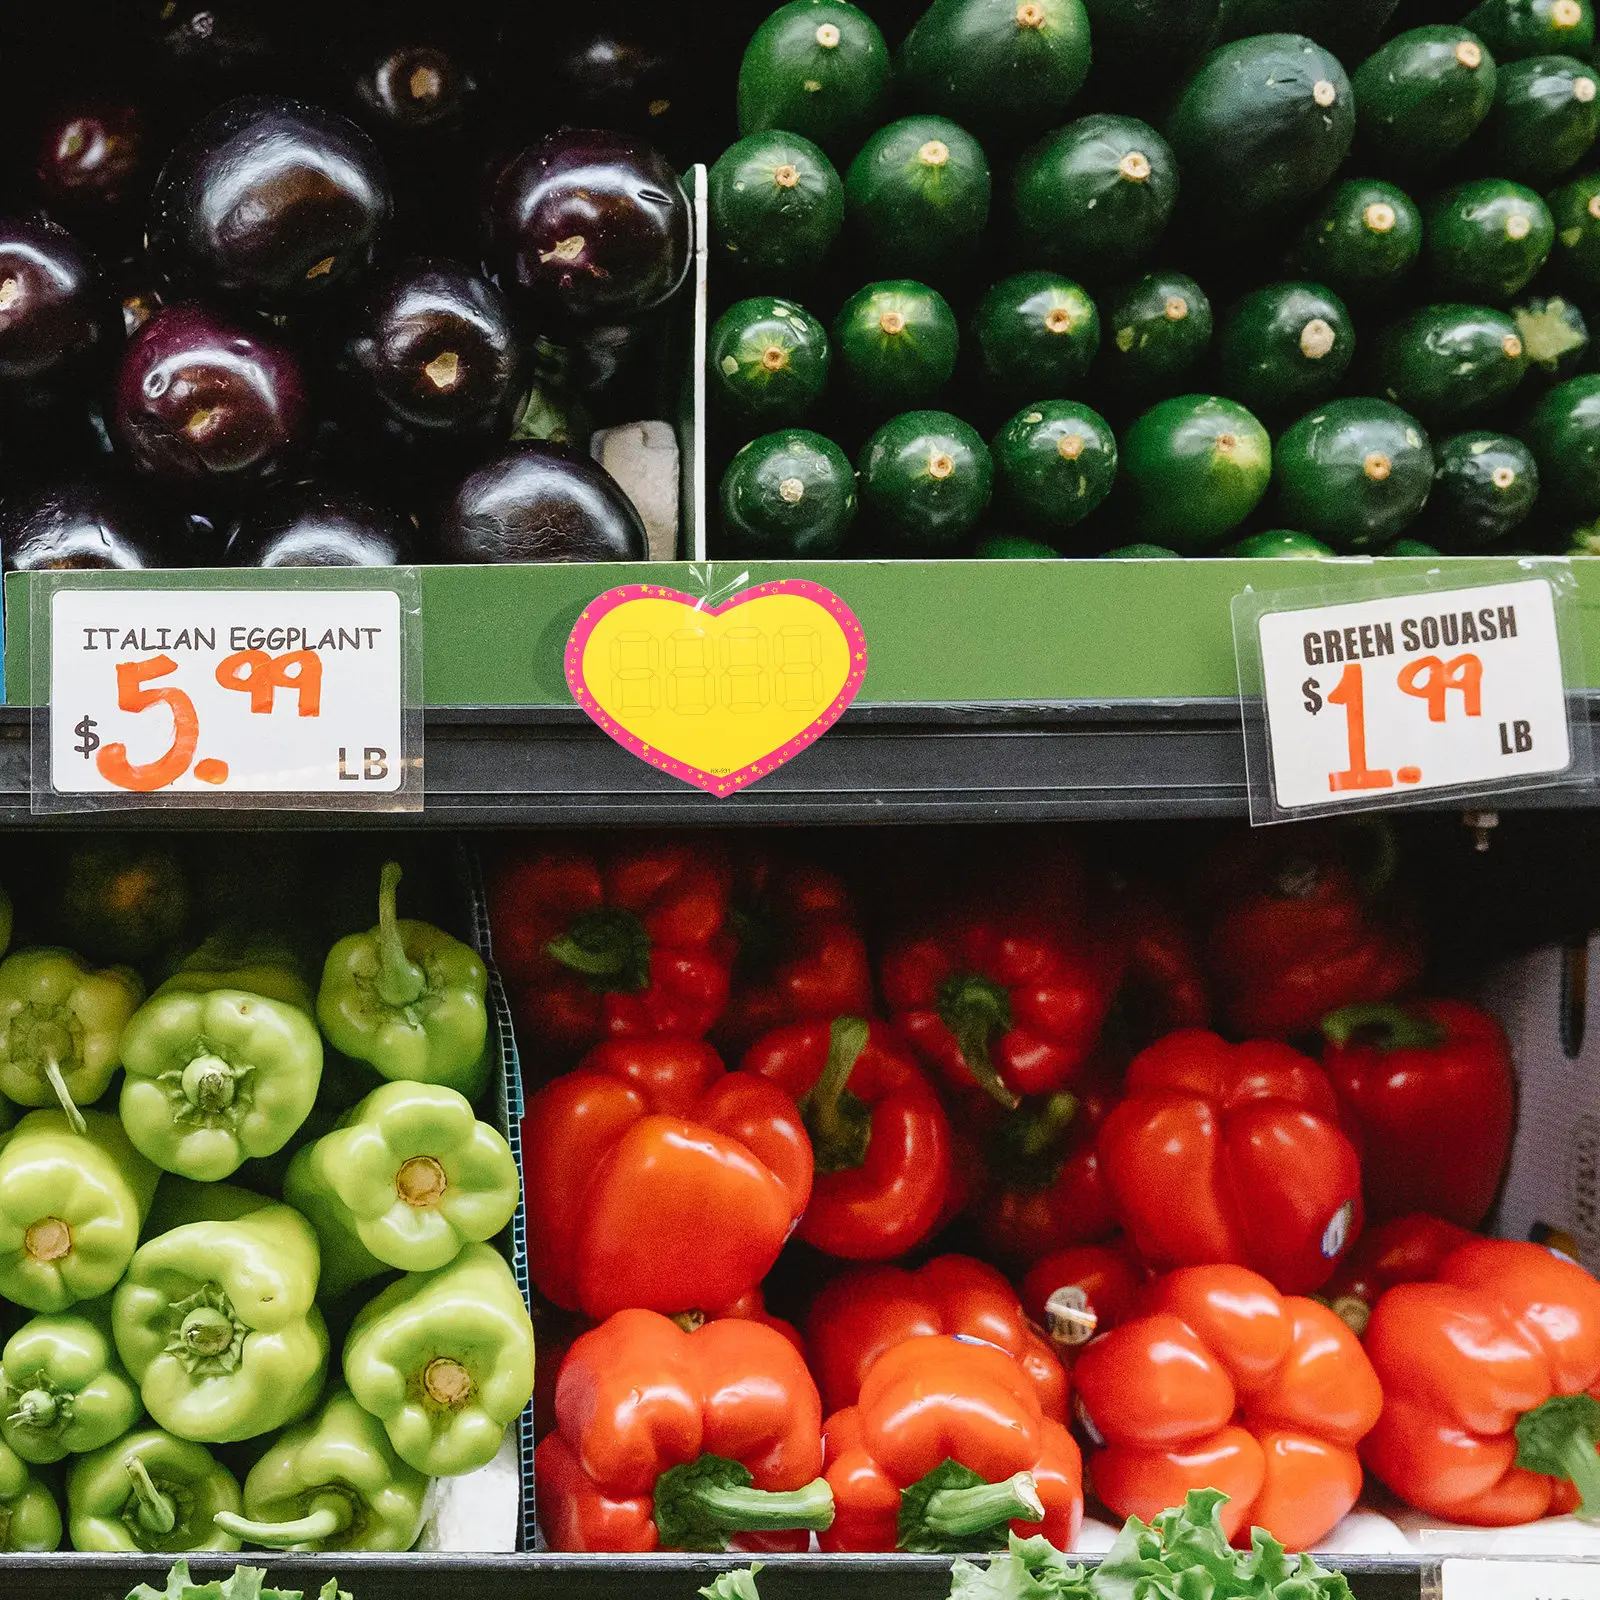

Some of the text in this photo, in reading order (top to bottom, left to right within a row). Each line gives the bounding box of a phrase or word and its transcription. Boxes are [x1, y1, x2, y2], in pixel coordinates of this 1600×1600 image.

[83, 627, 382, 651] ITALIAN EGGPLANT
[1303, 605, 1519, 666] GREEN SQUASH
[1499, 720, 1533, 755] LB
[338, 747, 389, 781] LB
